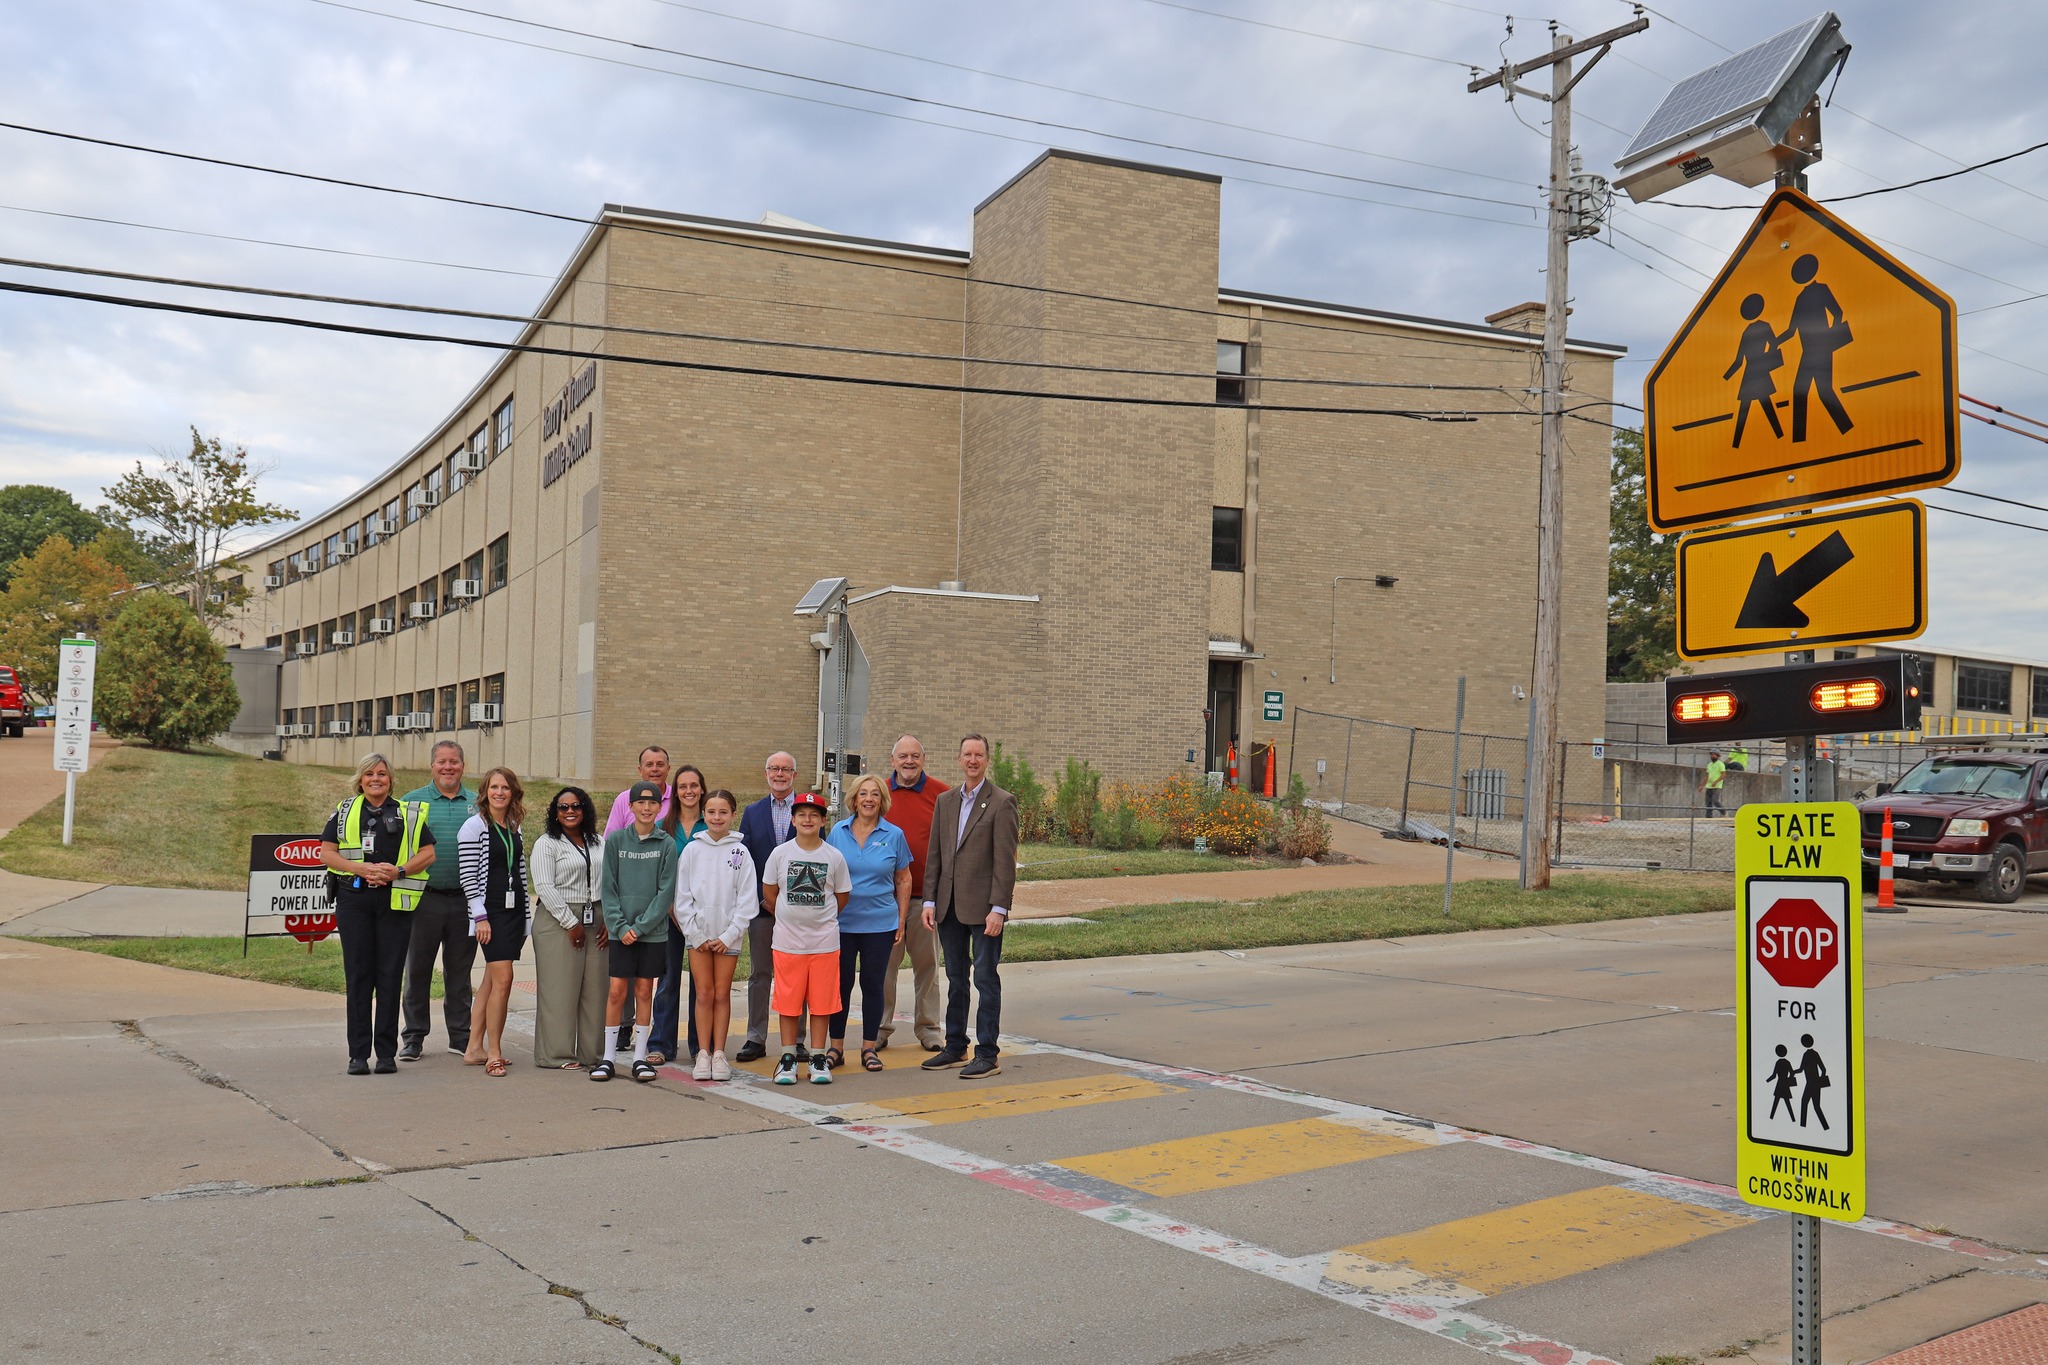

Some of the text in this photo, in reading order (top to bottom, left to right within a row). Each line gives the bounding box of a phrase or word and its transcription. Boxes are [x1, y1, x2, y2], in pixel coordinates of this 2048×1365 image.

[569, 360, 596, 414] Truman
[543, 412, 592, 489] Middle School
[1757, 813, 1835, 837] STATE
[280, 846, 321, 860] DANG
[618, 850, 660, 859] ET OUTDOORS
[1769, 845, 1822, 868] LAW
[280, 874, 327, 890] OVERHEA
[271, 896, 308, 911] POWER
[788, 893, 825, 903] Reebok
[1761, 925, 1833, 960] STOP
[1778, 1000, 1816, 1020] FOR
[1770, 1154, 1828, 1181] WITHIN
[1749, 1176, 1851, 1211] CROSSWALK
